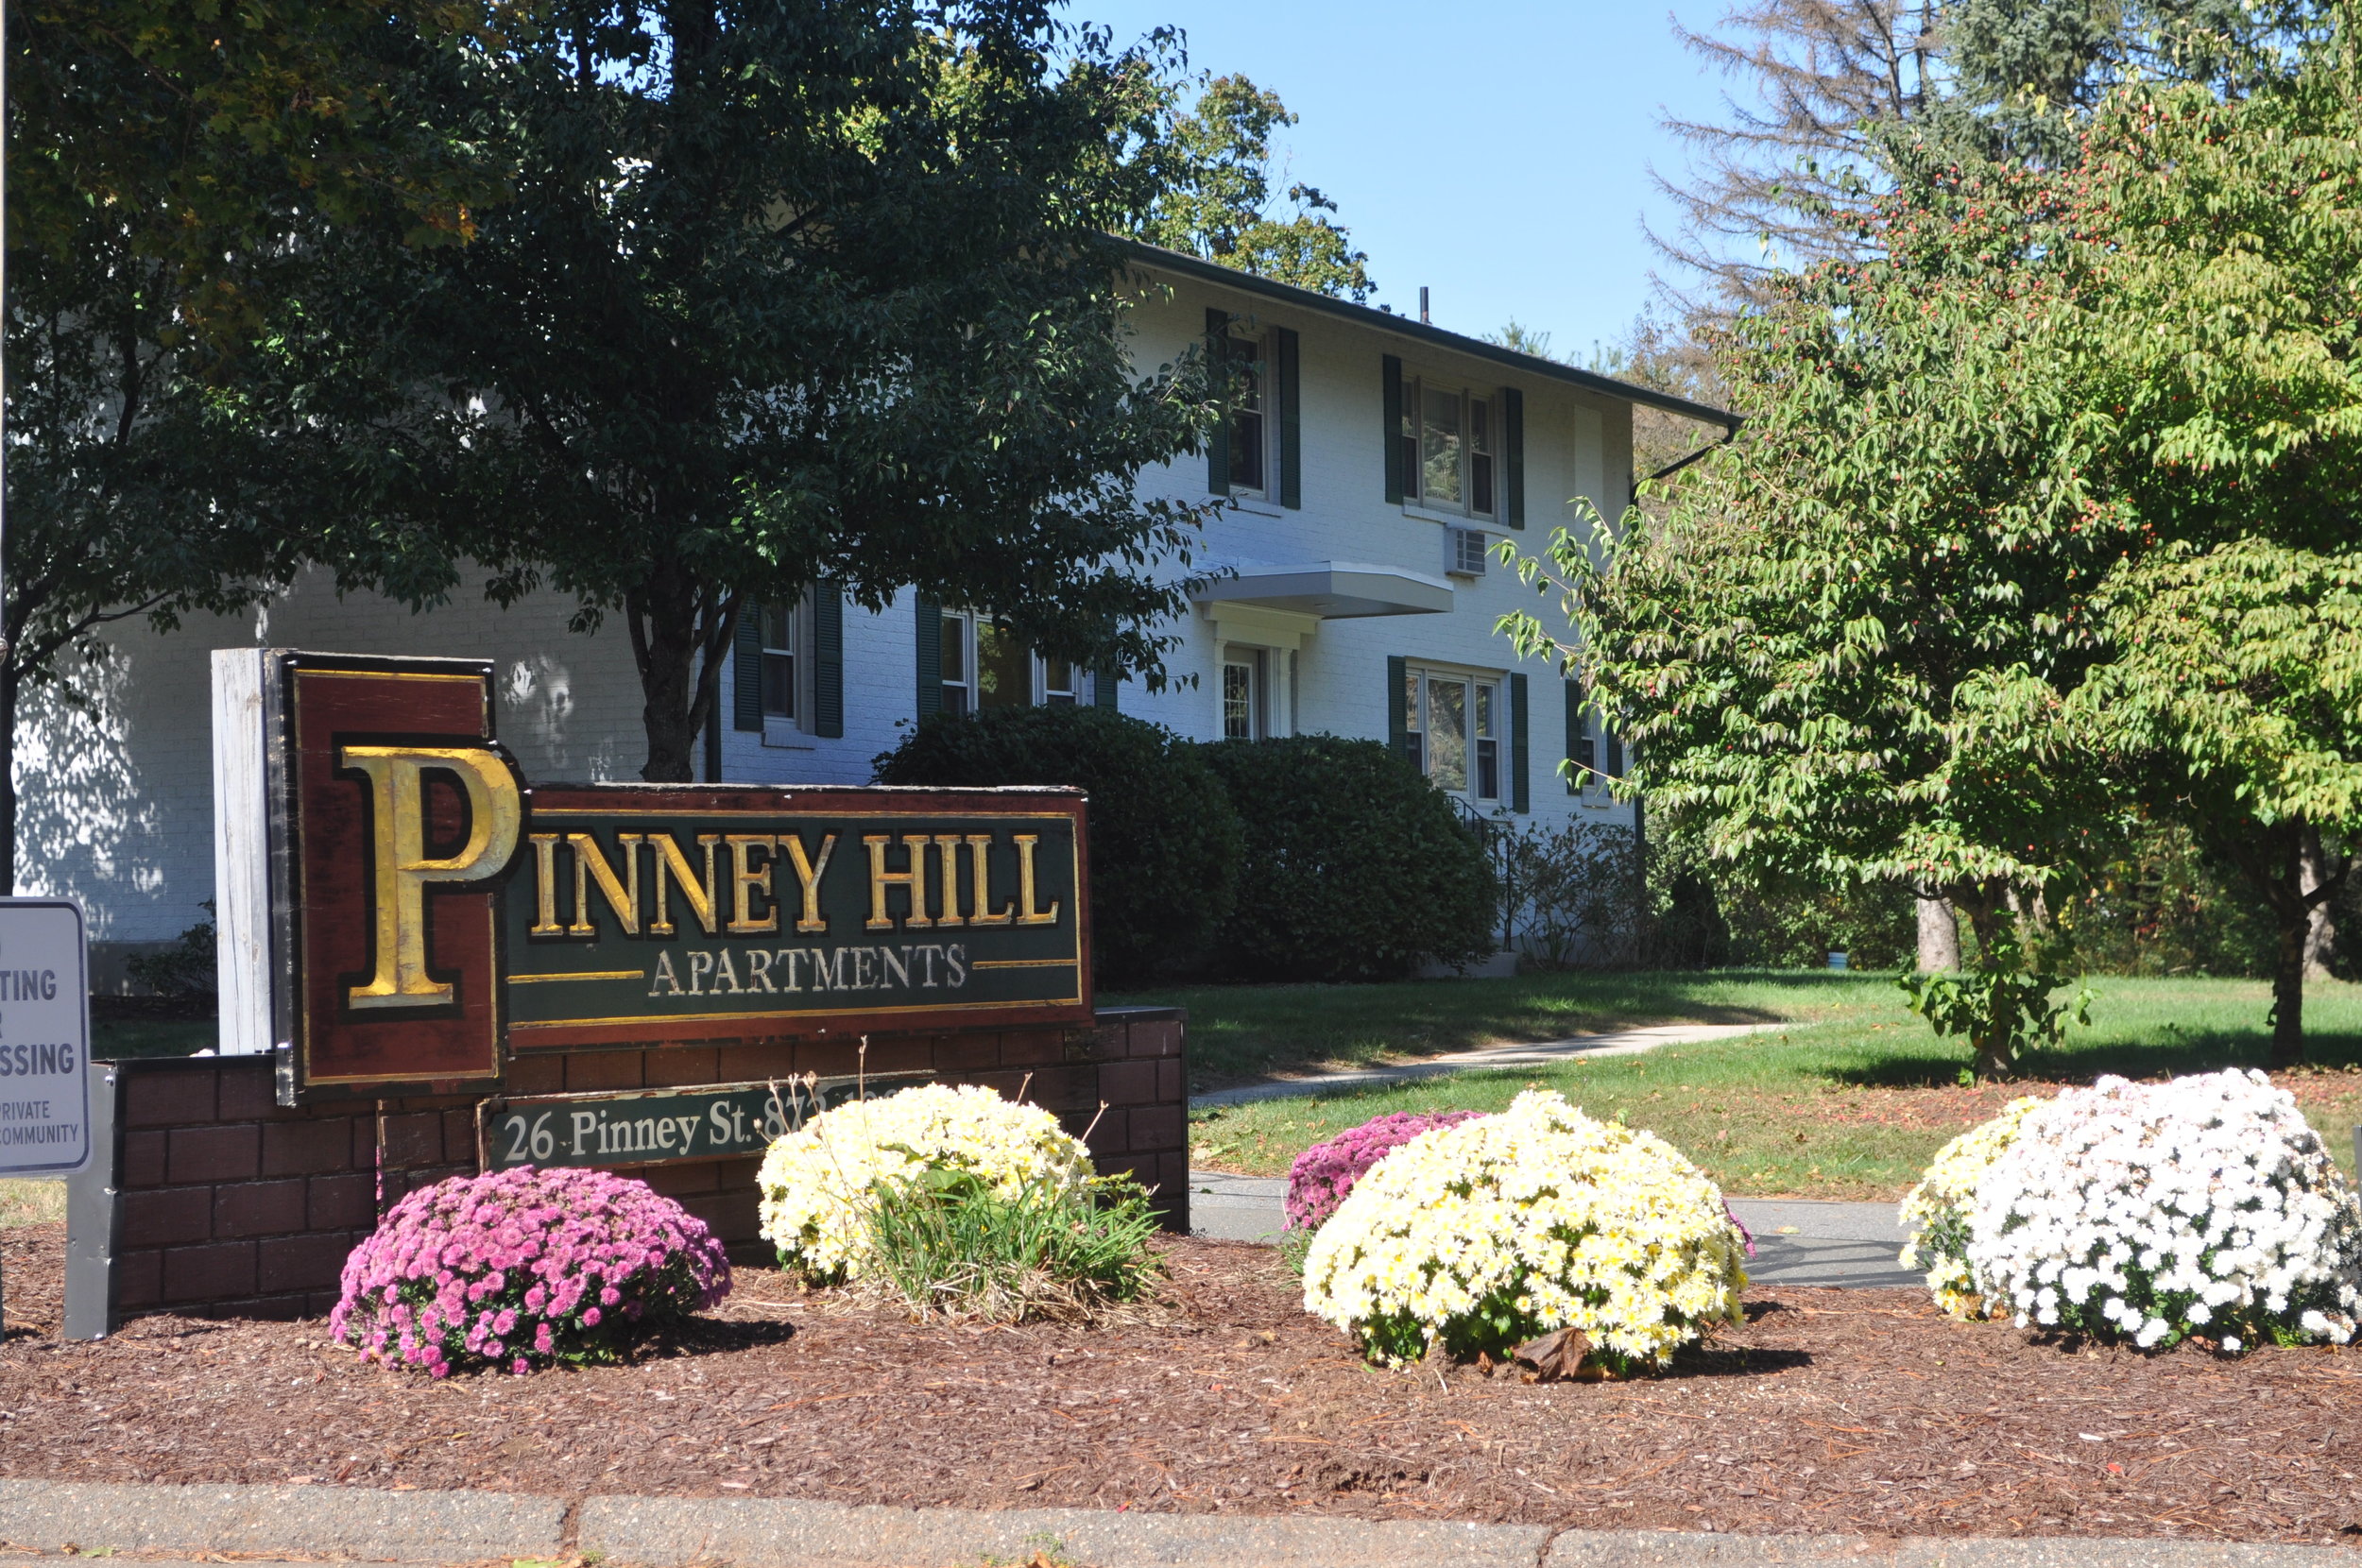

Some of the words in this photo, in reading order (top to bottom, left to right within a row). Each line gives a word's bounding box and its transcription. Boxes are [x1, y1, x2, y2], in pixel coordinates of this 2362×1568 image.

[341, 744, 837, 1008] PINNEY
[863, 833, 1059, 929] HILL
[648, 945, 967, 998] APARTMENTS
[0, 1099, 51, 1121] RIVATE
[0, 1123, 78, 1146] OMMUNITY
[504, 1111, 554, 1162] 26
[570, 1109, 700, 1156] Pinney
[710, 1099, 752, 1146] St.
